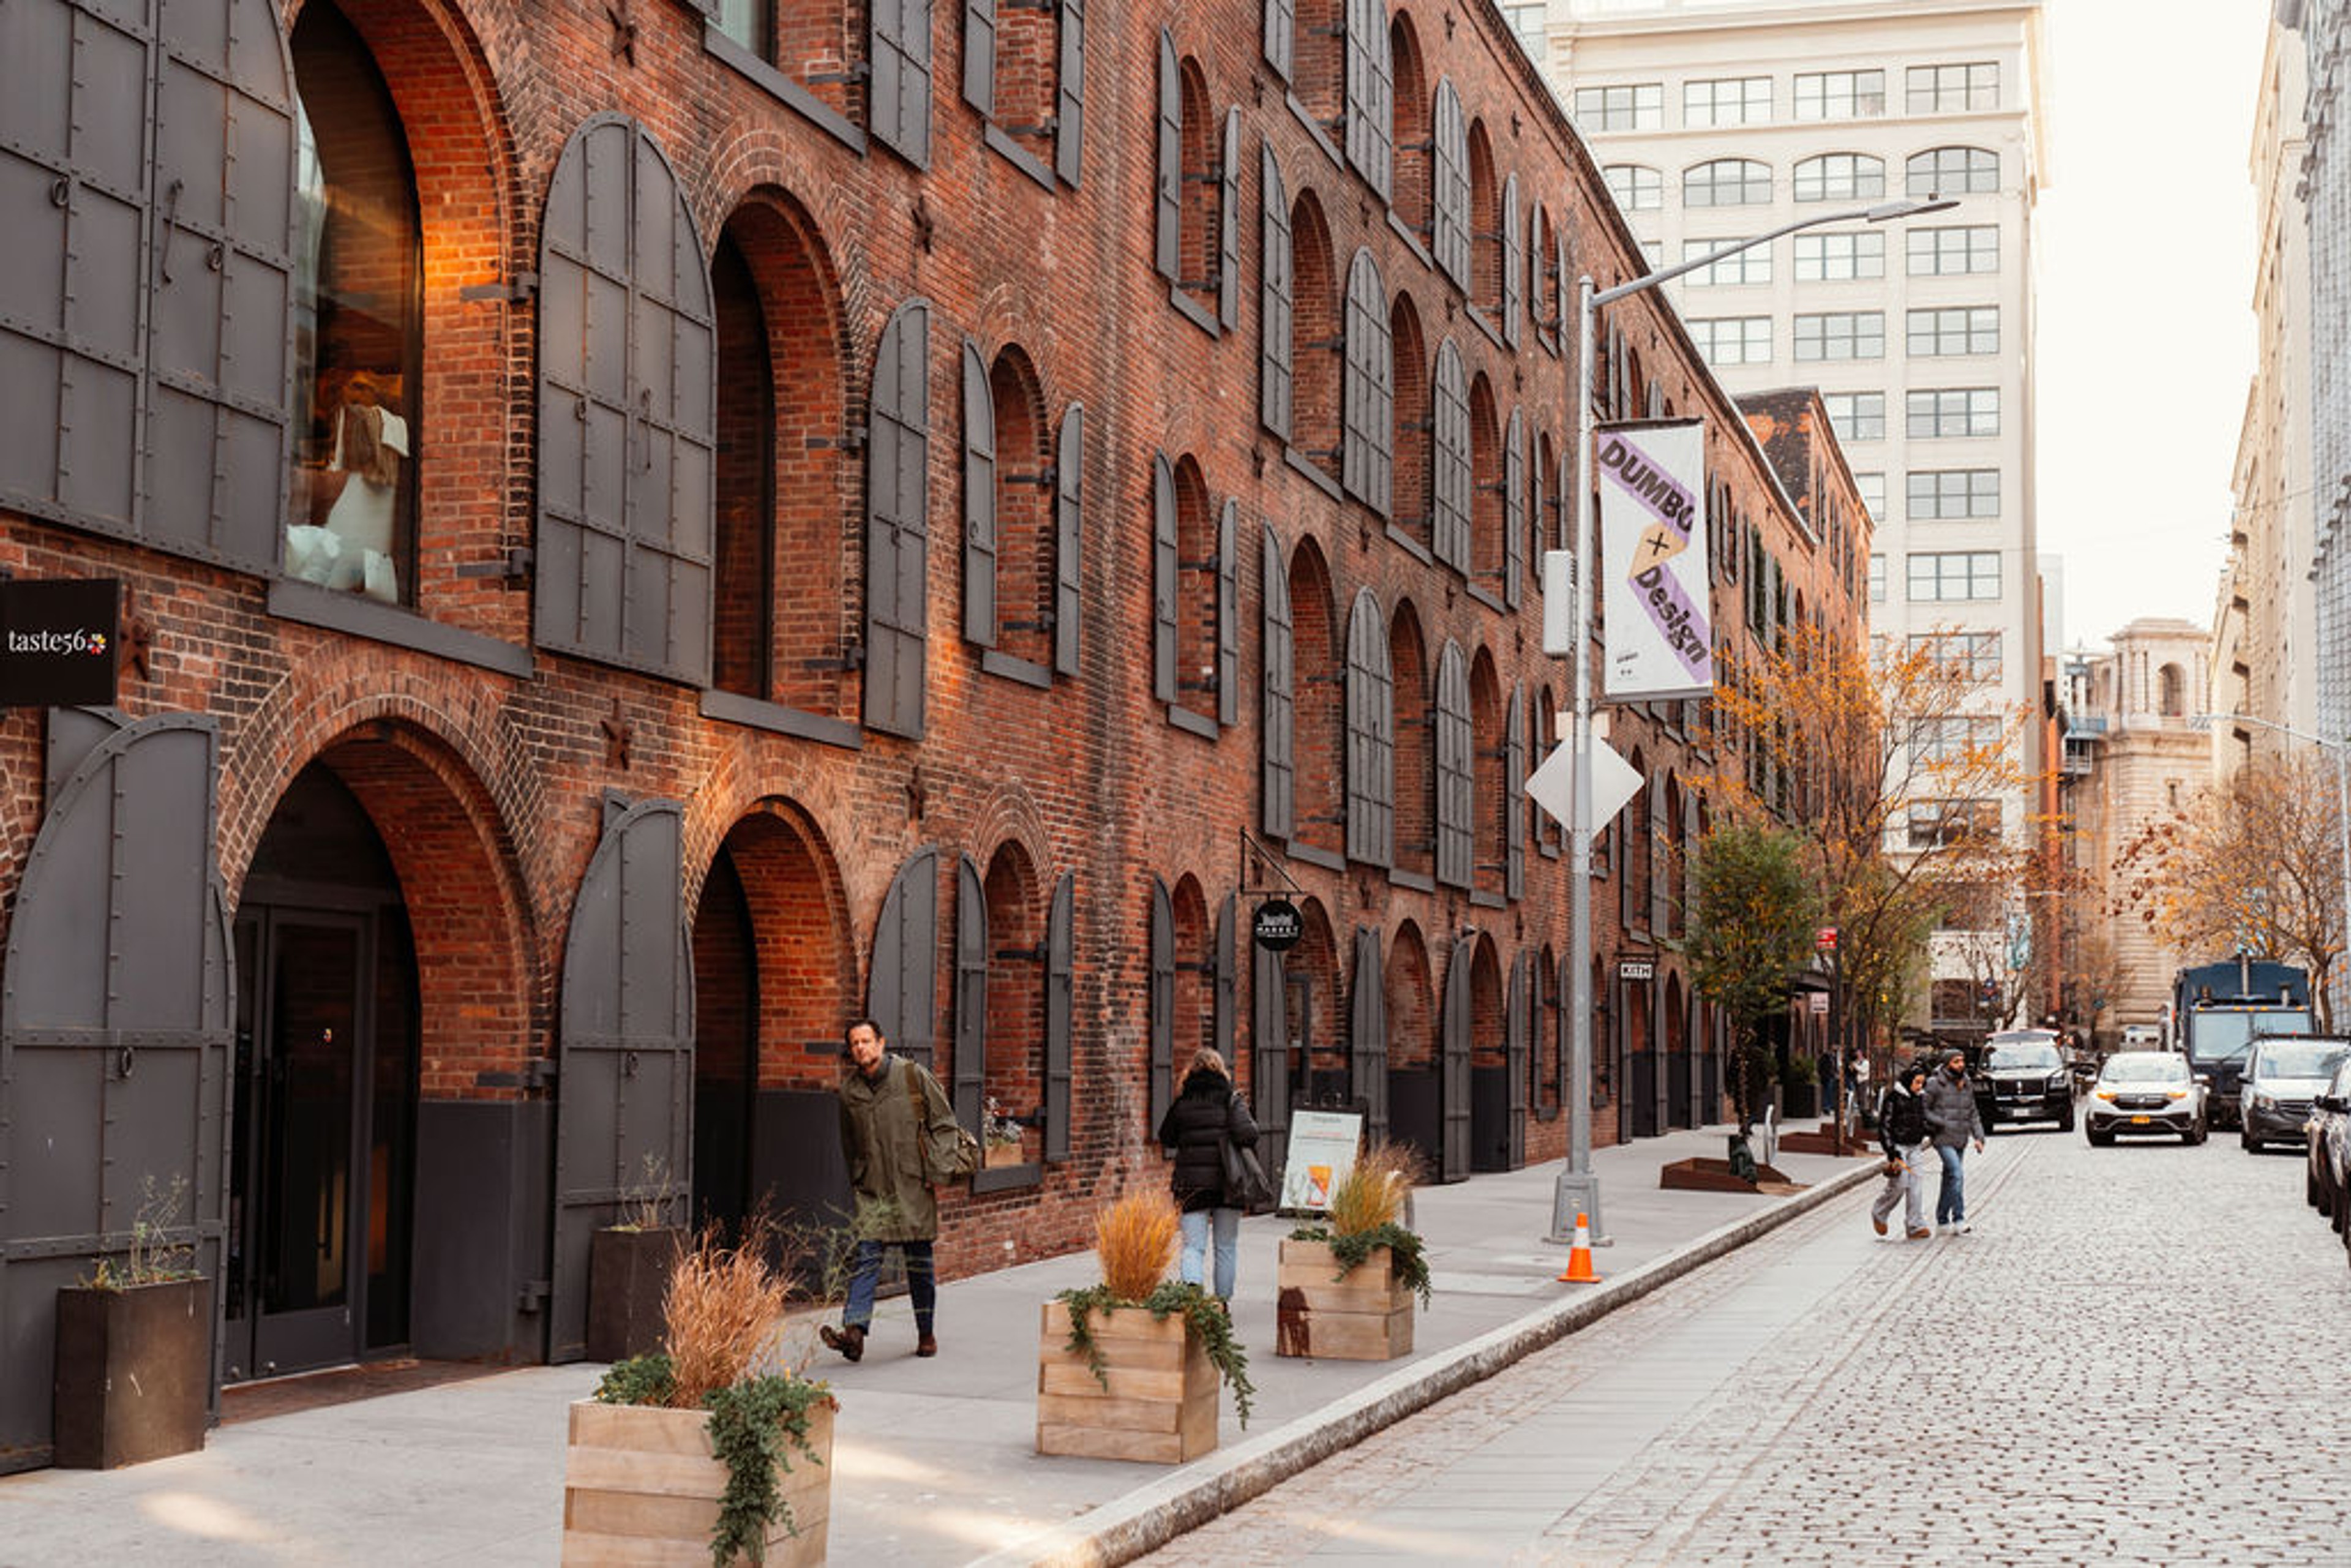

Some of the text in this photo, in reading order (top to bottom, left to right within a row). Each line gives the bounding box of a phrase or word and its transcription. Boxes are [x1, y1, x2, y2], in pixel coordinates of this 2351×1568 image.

[1600, 438, 1695, 533] DUMBO
[9, 629, 86, 655] taste56
[1635, 566, 1708, 664] Design
